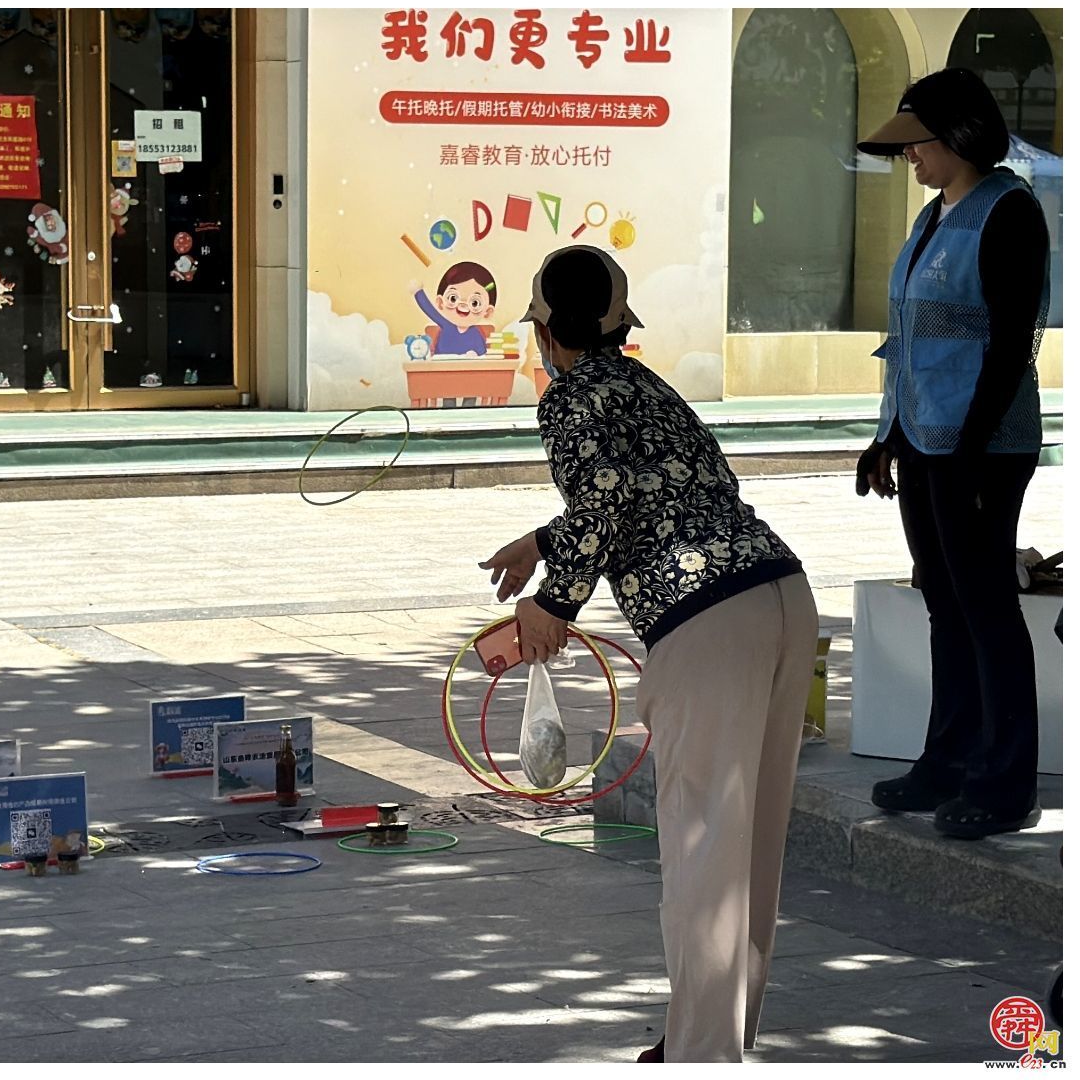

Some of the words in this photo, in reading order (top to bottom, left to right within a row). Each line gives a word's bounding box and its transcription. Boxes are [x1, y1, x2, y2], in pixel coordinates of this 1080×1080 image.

[381, 8, 672, 69] 我们更专业
[392, 97, 658, 120] 午托晚托/假期托管/幼小衔接/书法美术
[138, 144, 198, 153] 18553123881
[439, 143, 612, 167] 嘉睿教育·放心托付
